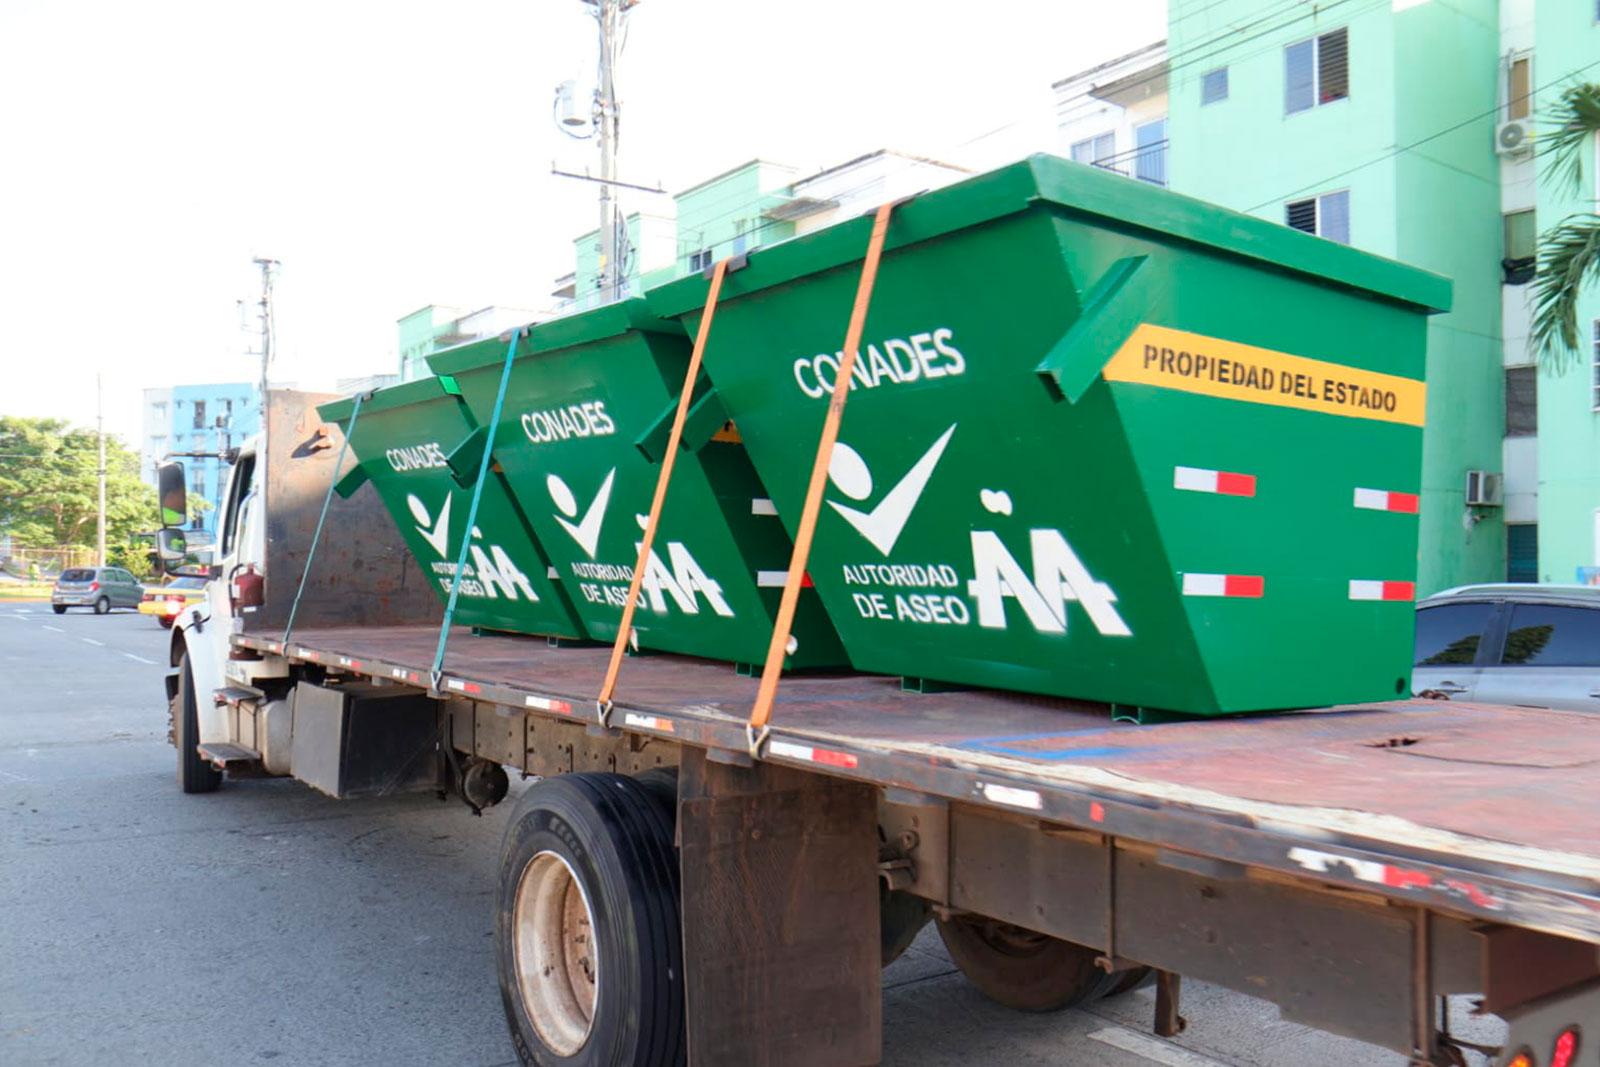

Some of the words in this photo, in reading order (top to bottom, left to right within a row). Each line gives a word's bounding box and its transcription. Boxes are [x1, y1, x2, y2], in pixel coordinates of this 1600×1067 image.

[793, 328, 966, 399] CONADES
[1143, 344, 1275, 392] PROPIEDAD
[1280, 371, 1317, 401] DEL
[1322, 379, 1397, 414] ESTADO
[520, 401, 616, 444] CONADES
[385, 442, 448, 472] CONADES
[570, 562, 634, 582] AUTORIDAD
[843, 564, 959, 587] AUTORIDAD
[580, 583, 605, 604] DE
[852, 593, 891, 620] DE
[895, 595, 970, 625] ASEO
